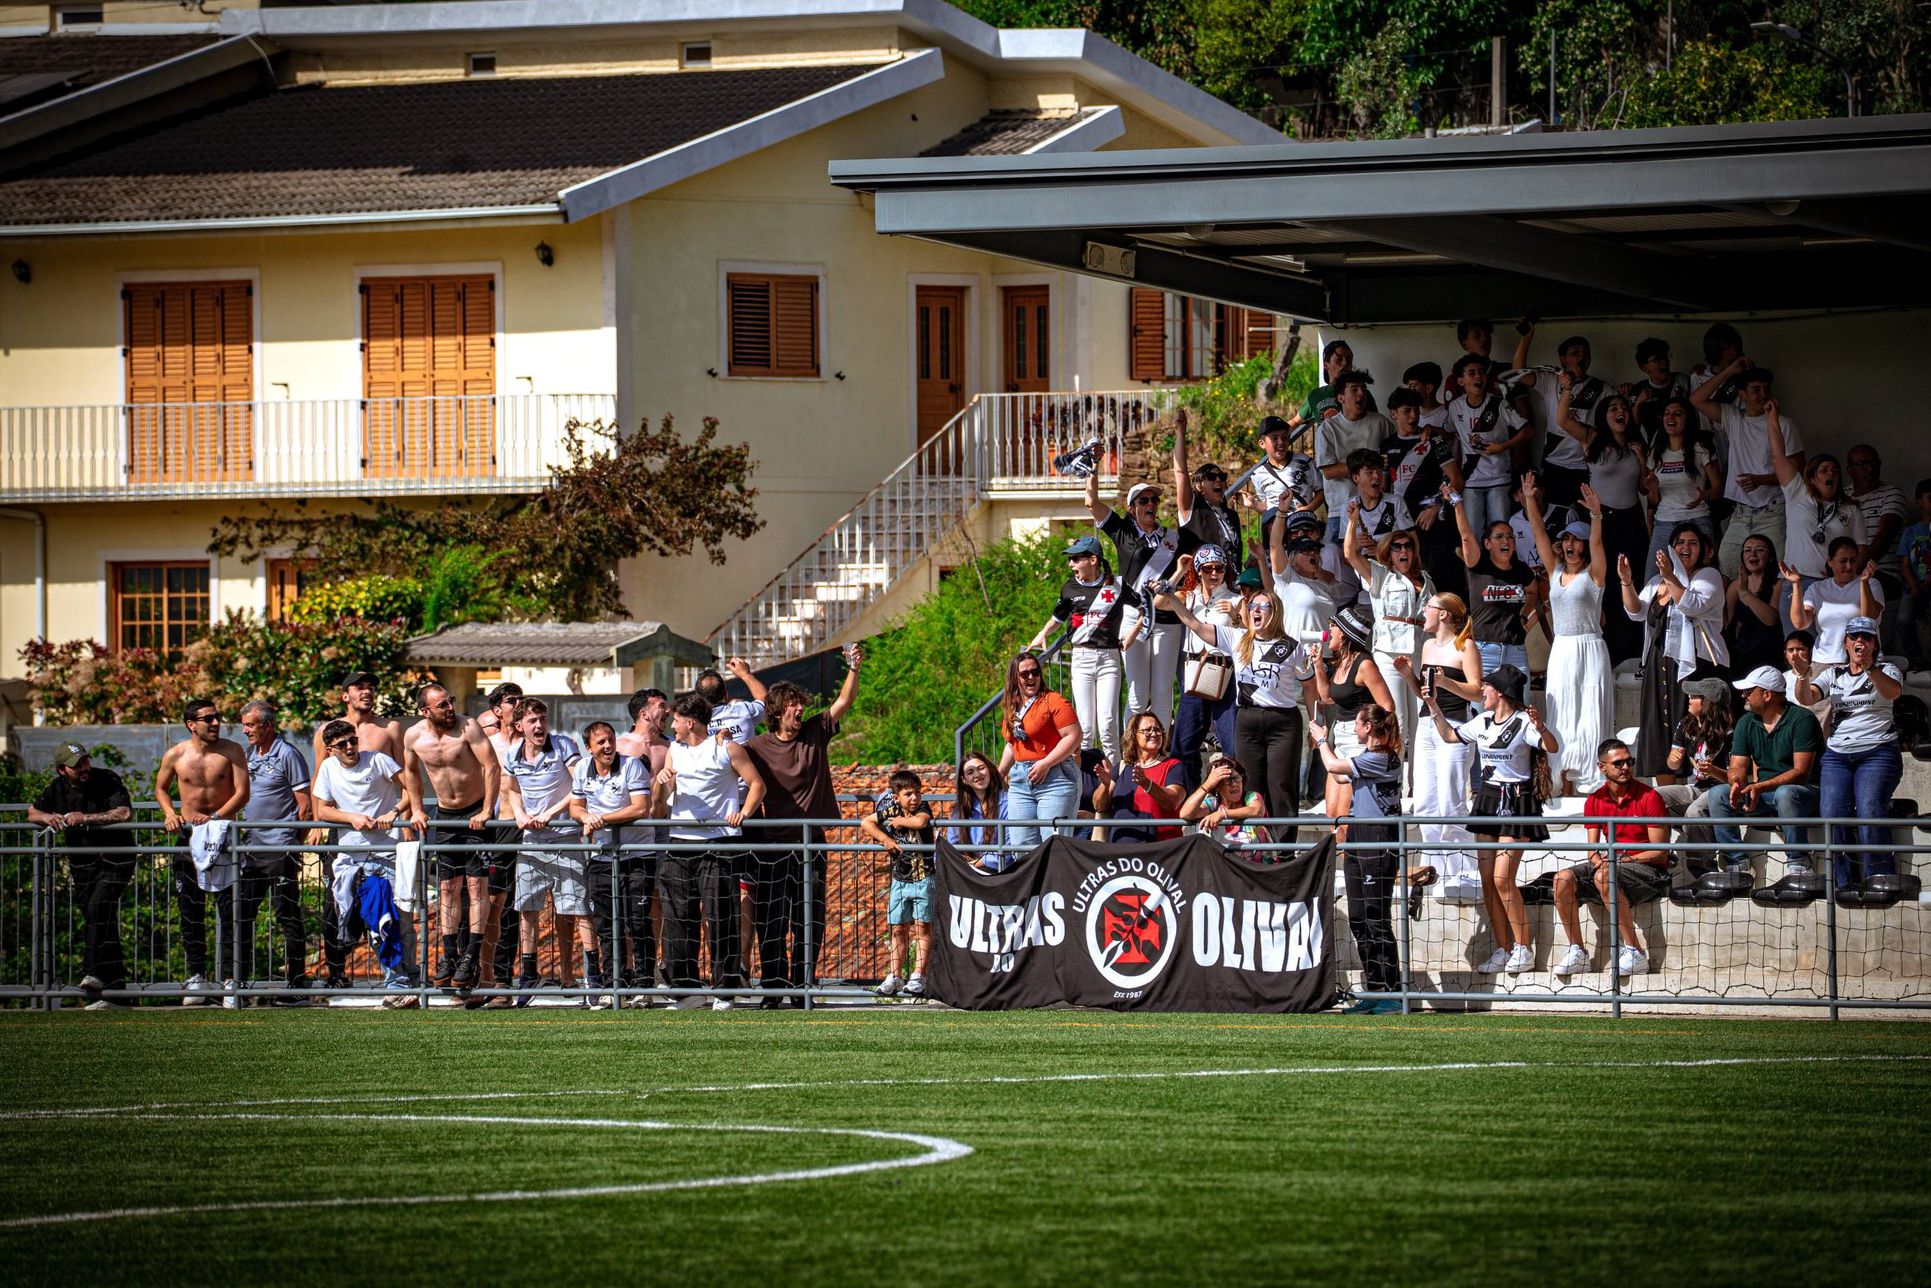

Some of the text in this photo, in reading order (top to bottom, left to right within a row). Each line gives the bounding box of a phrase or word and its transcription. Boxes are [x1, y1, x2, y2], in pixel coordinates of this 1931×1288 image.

[1072, 857, 1187, 914] ULTRAS DO OLIVAL
[949, 891, 1066, 954] ULTRAS
